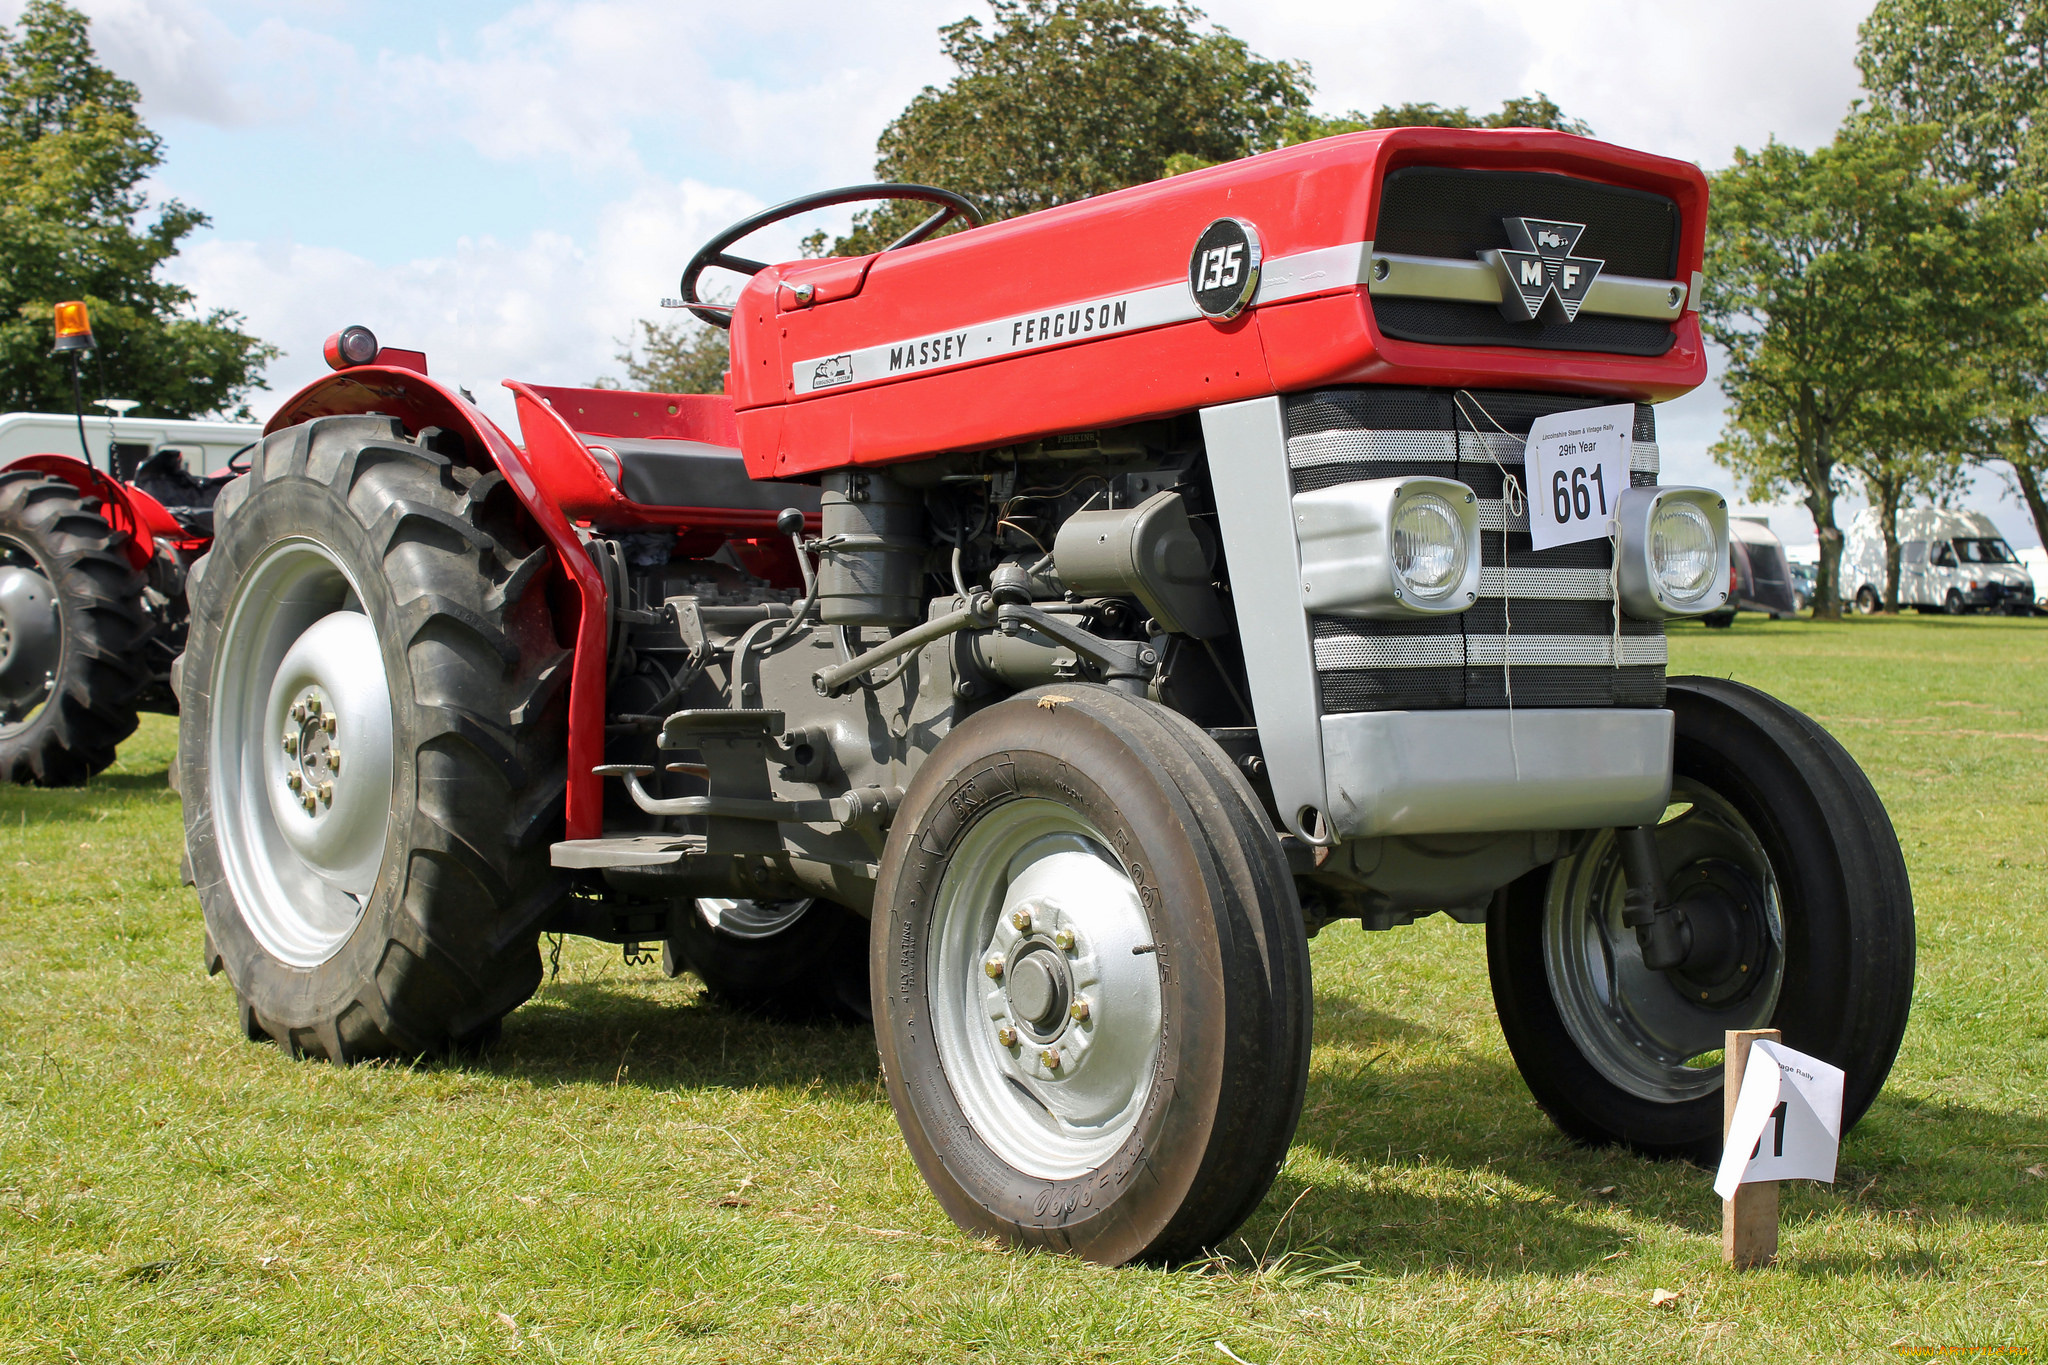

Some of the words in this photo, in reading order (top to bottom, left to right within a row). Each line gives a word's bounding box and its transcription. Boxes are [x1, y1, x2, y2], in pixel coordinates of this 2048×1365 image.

[1196, 242, 1244, 293] 135
[1521, 260, 1542, 287] M
[1563, 265, 1580, 290] F
[889, 333, 968, 371] MASSEY
[1012, 300, 1128, 347] FERGUSON
[1542, 430, 1568, 441] Lincolnshire
[1567, 428, 1582, 437] Steam
[1586, 426, 1603, 436] Vintage
[1602, 424, 1615, 432] Rally
[1558, 444, 1577, 457] 29th
[1578, 441, 1597, 453] Year
[1552, 463, 1607, 525] 661
[949, 782, 985, 821] BKT
[900, 920, 913, 968] RATING
[1778, 1062, 1795, 1073] tage
[1796, 1068, 1814, 1081] Rally
